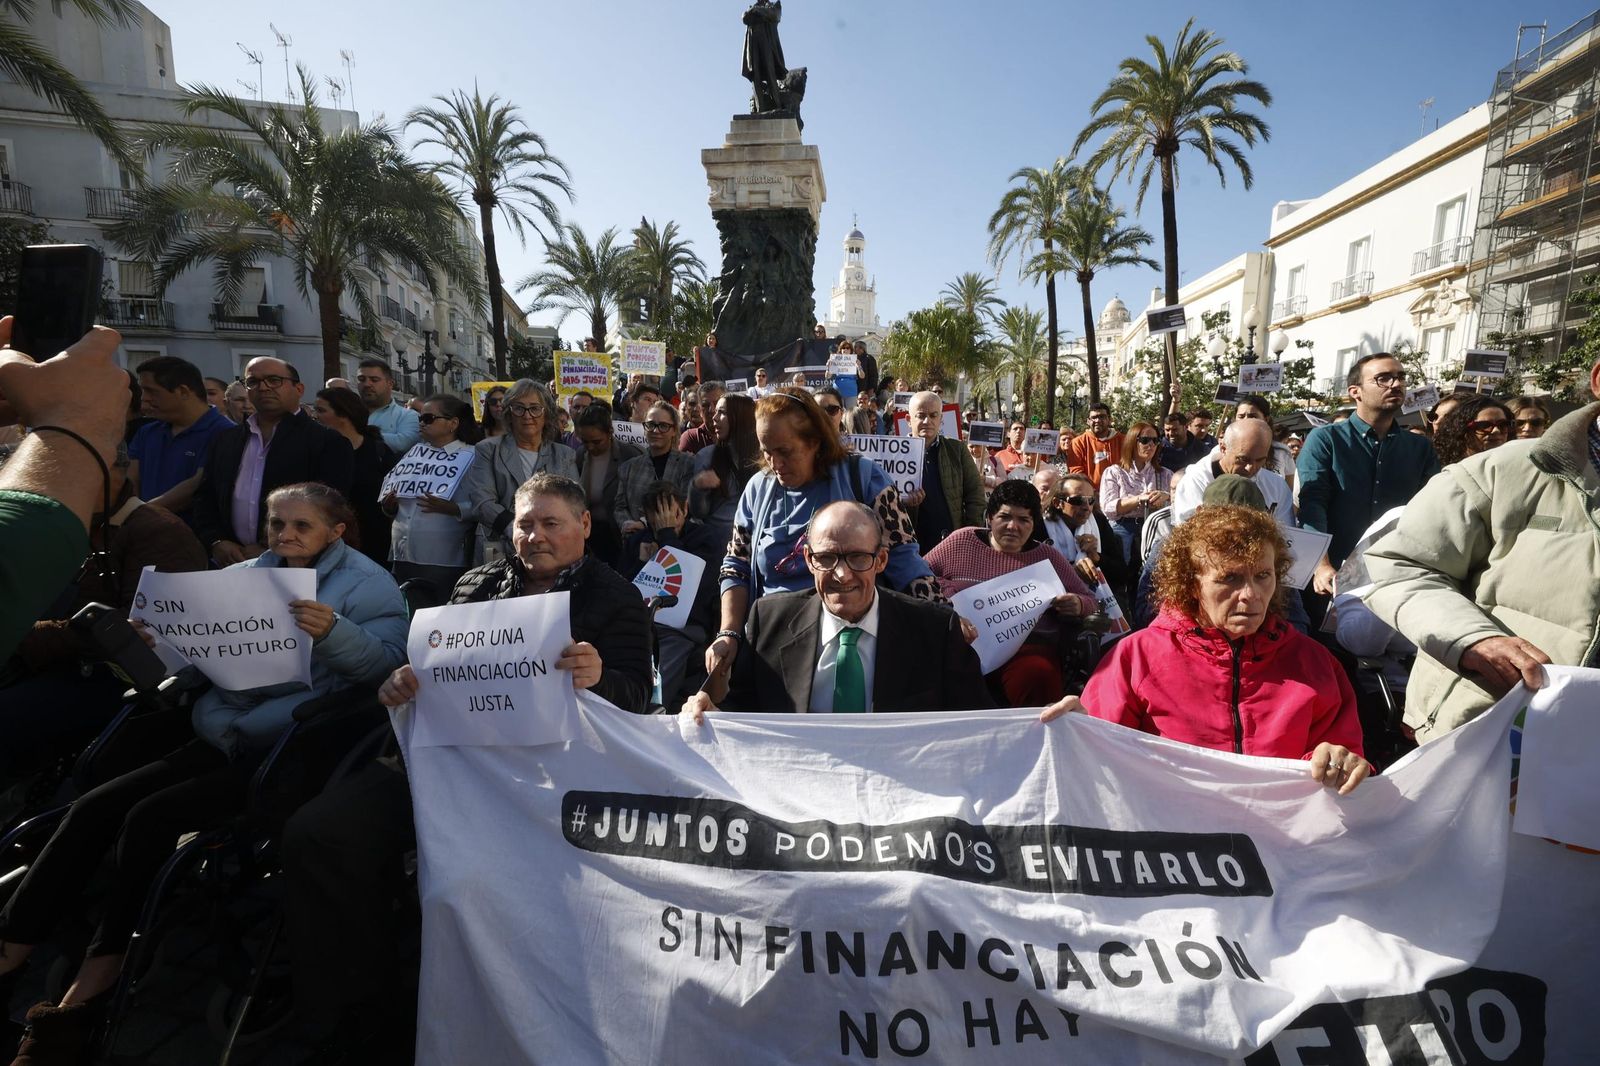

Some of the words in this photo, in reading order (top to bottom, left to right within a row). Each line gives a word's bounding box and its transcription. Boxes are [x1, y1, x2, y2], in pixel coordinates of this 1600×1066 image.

[582, 375, 607, 385] JUSTA
[617, 423, 632, 433] SIN
[988, 583, 1036, 606] #JUNTOS
[153, 600, 185, 613] SIN
[985, 596, 1043, 627] PODEMOS
[150, 616, 274, 636] NANCIACIÓN
[995, 617, 1036, 643] EVITAR
[218, 637, 297, 658] FUTURO
[445, 630, 485, 650] #POR
[490, 627, 525, 646] UNA
[433, 657, 547, 683] FINANCIACIÓN
[468, 694, 515, 712] JUSTA
[1020, 844, 1246, 888] EVITARLO
[659, 906, 742, 966] SIN
[765, 921, 1265, 990] FINANCIACIÓN
[839, 1008, 930, 1058] NO
[962, 998, 1080, 1048] HAY
